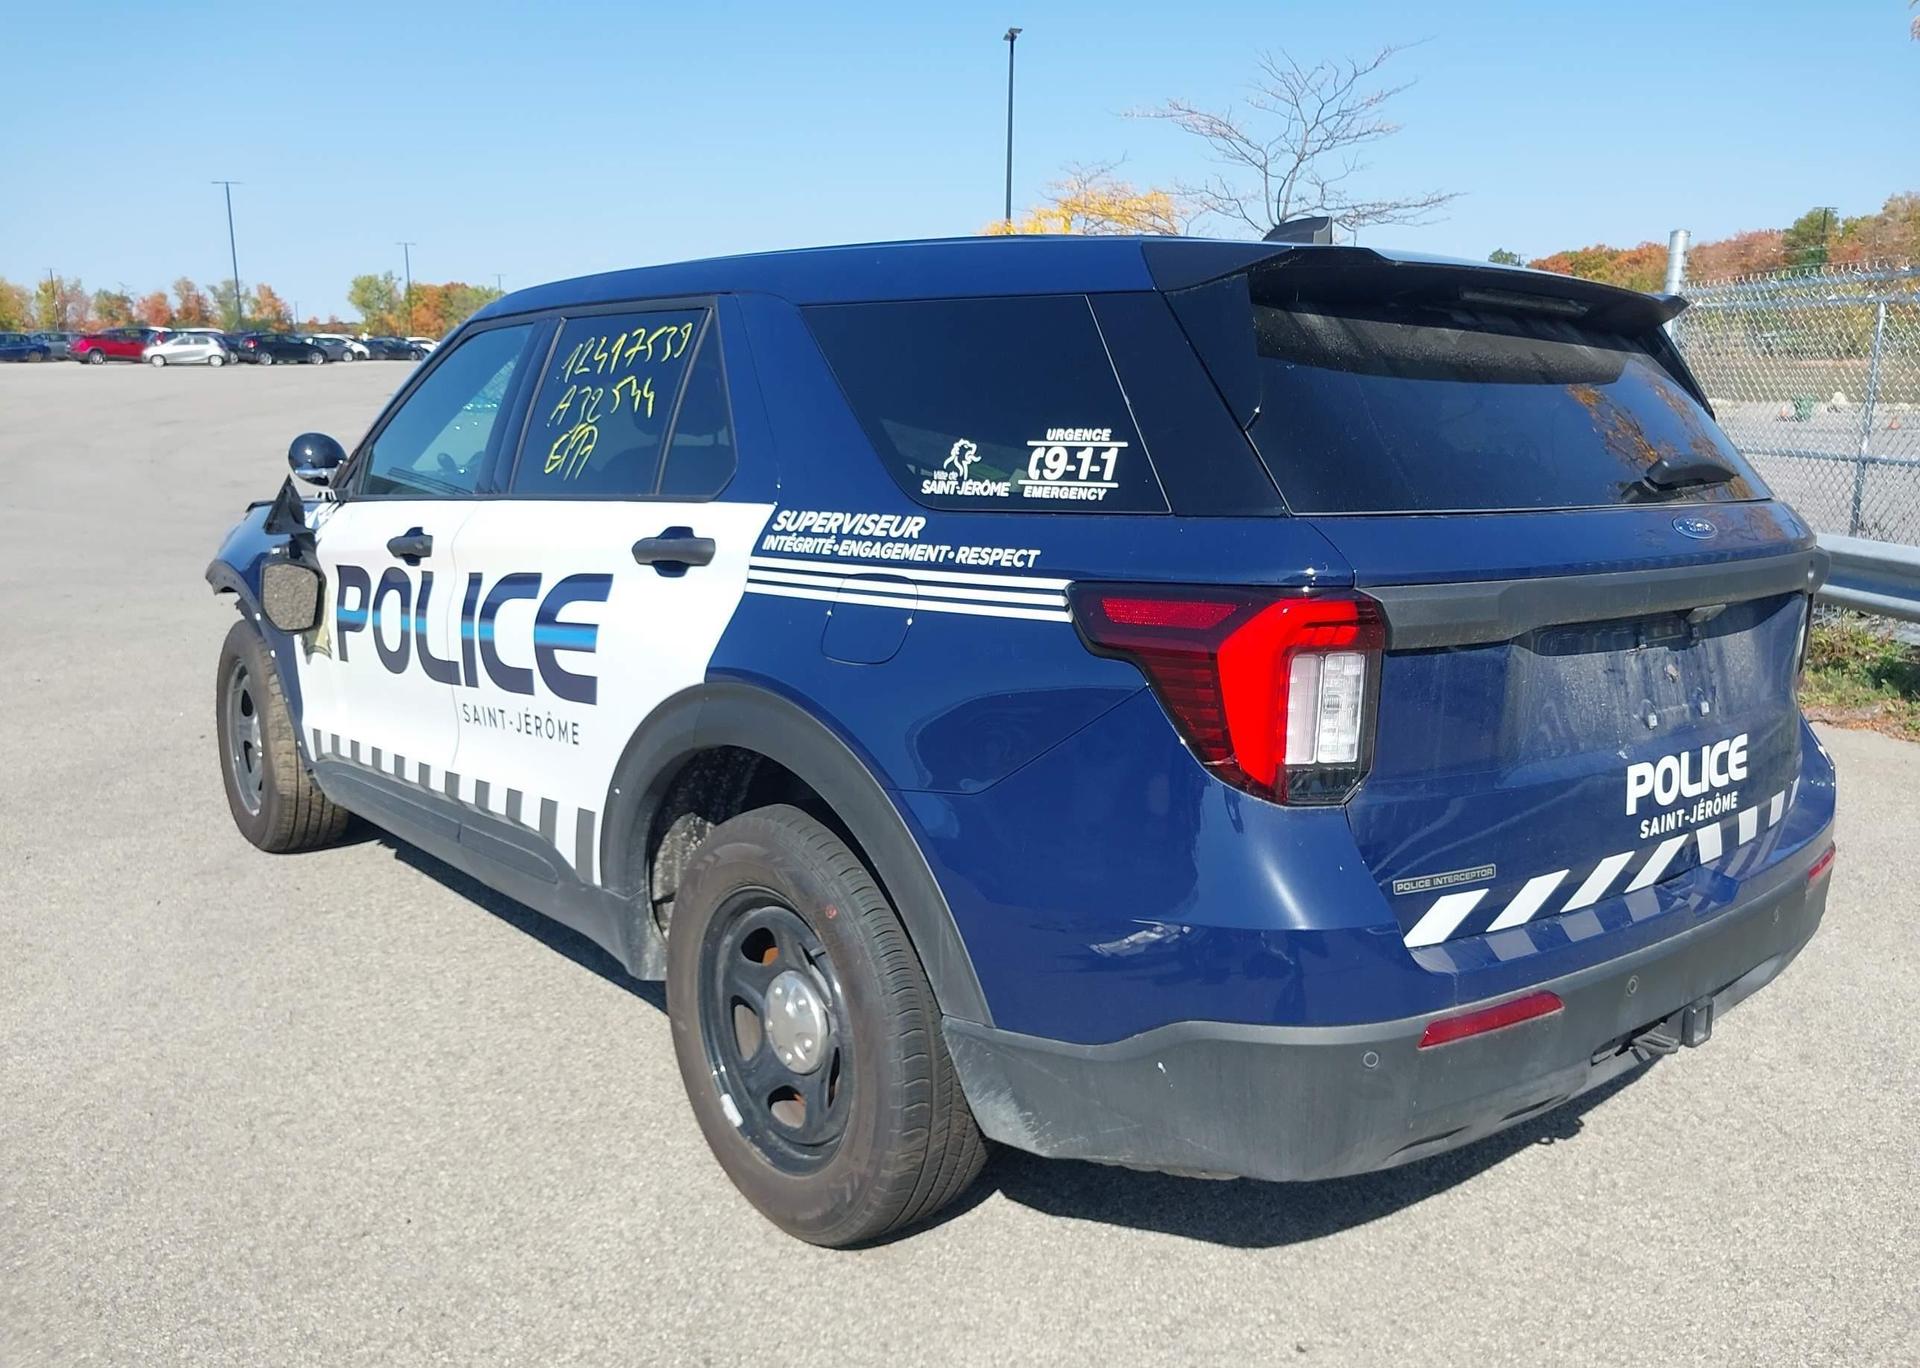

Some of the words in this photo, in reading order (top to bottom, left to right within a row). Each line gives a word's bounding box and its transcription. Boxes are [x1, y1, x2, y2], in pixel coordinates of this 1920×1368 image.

[1046, 428, 1112, 442] URGENCE
[921, 478, 1012, 497] SAINT-JÉRÔME
[1023, 485, 1108, 501] EMERGENCY
[772, 509, 927, 539] SUPERVISEUR
[336, 564, 614, 706] POLICE
[463, 702, 580, 745] SAINT-JÉRÔME
[1625, 733, 1748, 816] POLICE
[1640, 791, 1738, 840] SAINT-JÉRÔME
[1396, 879, 1432, 892] POLICE
[1433, 867, 1494, 886] INTERCEPTOR
